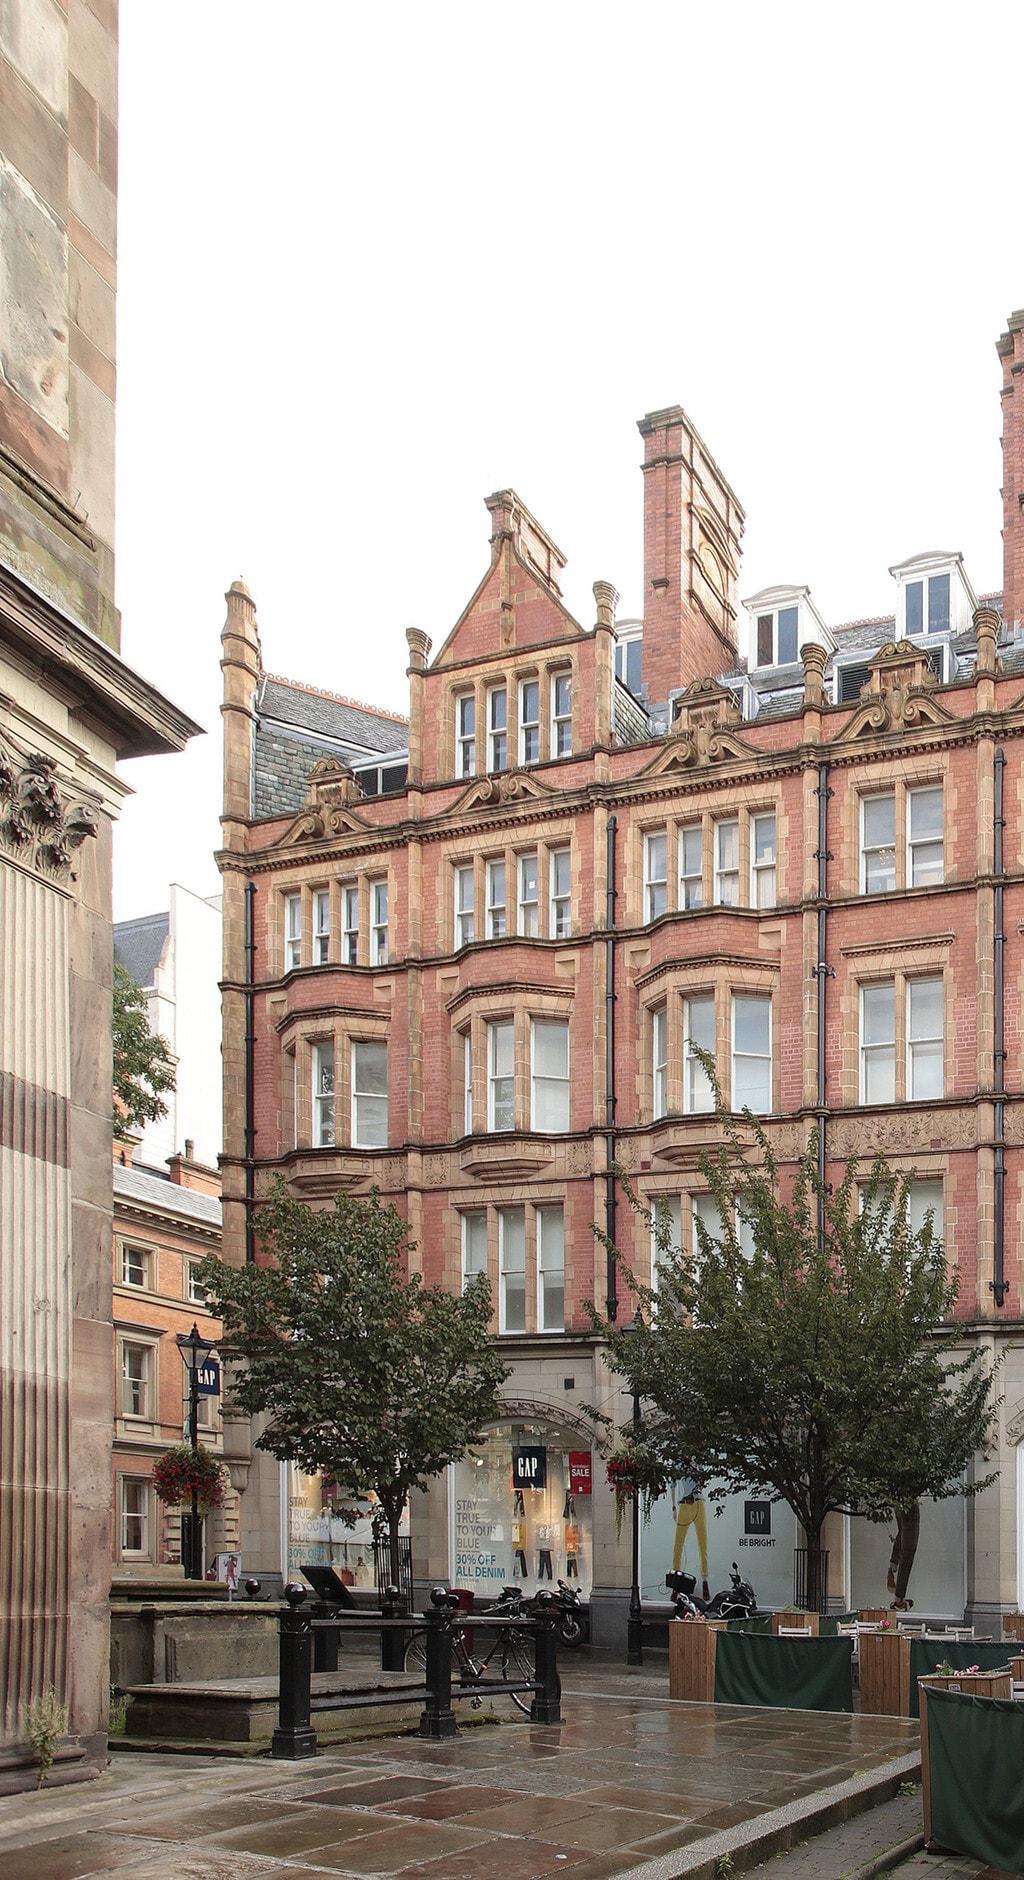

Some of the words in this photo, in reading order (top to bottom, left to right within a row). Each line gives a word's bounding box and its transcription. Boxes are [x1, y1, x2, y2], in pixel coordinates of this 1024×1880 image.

[197, 1369, 216, 1386] GAP
[518, 1457, 538, 1477] GAP
[571, 1468, 590, 1477] SALE
[289, 1497, 308, 1507] STAY
[456, 1500, 478, 1511] STAY
[289, 1508, 311, 1519] TRUE
[456, 1513, 480, 1523] TRUE
[750, 1510, 765, 1525] GAP
[289, 1520, 300, 1531] TO
[457, 1525, 469, 1535] TO
[289, 1532, 310, 1543] BLUE
[457, 1538, 480, 1548] BLUE
[739, 1538, 748, 1547] BE
[749, 1538, 776, 1547] BRIGHT
[289, 1548, 307, 1558] 30%
[308, 1548, 324, 1559] OFF
[456, 1554, 476, 1564] 30%
[478, 1554, 496, 1565] OFF
[456, 1566, 473, 1577] ALL
[475, 1567, 506, 1579] DENIM
